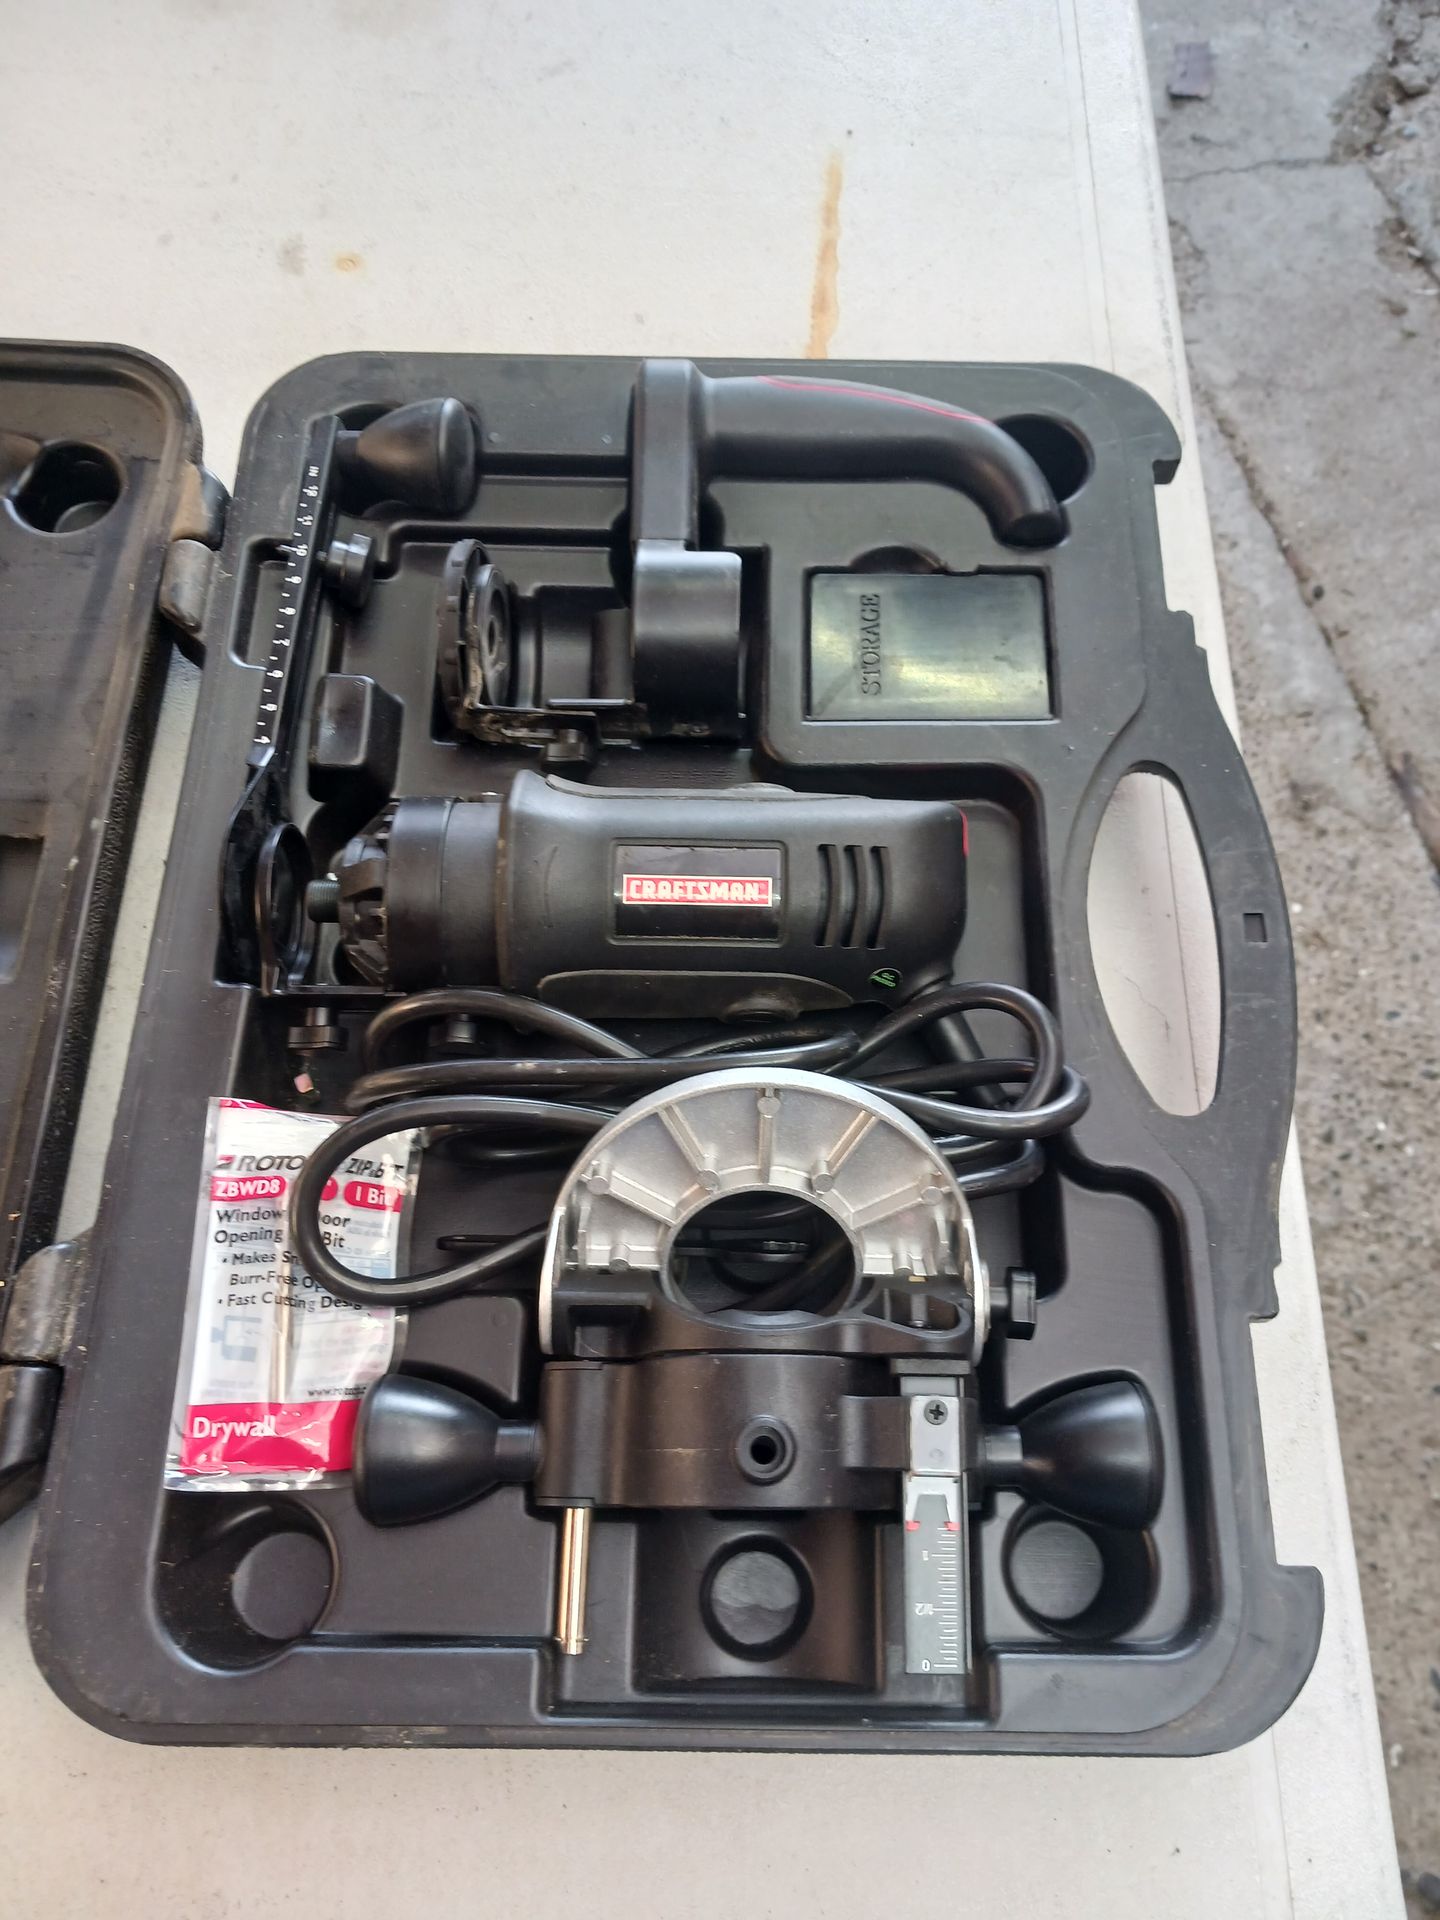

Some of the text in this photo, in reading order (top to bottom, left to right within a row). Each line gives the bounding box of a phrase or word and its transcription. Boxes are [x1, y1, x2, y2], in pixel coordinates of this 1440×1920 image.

[296, 543, 308, 557] 10
[859, 593, 882, 697] STORAGE
[629, 879, 760, 902] CRAFTSMAN
[215, 1178, 281, 1198] ZBWD8
[216, 1207, 352, 1228] Window oor
[214, 1227, 346, 1249] Opening Bit
[231, 1251, 276, 1266] Makes
[230, 1270, 298, 1287] Burr-Free
[226, 1293, 257, 1307] Fast
[261, 1291, 316, 1312] Cutting
[192, 1415, 276, 1444] Drywall
[921, 1659, 931, 1672] 0
